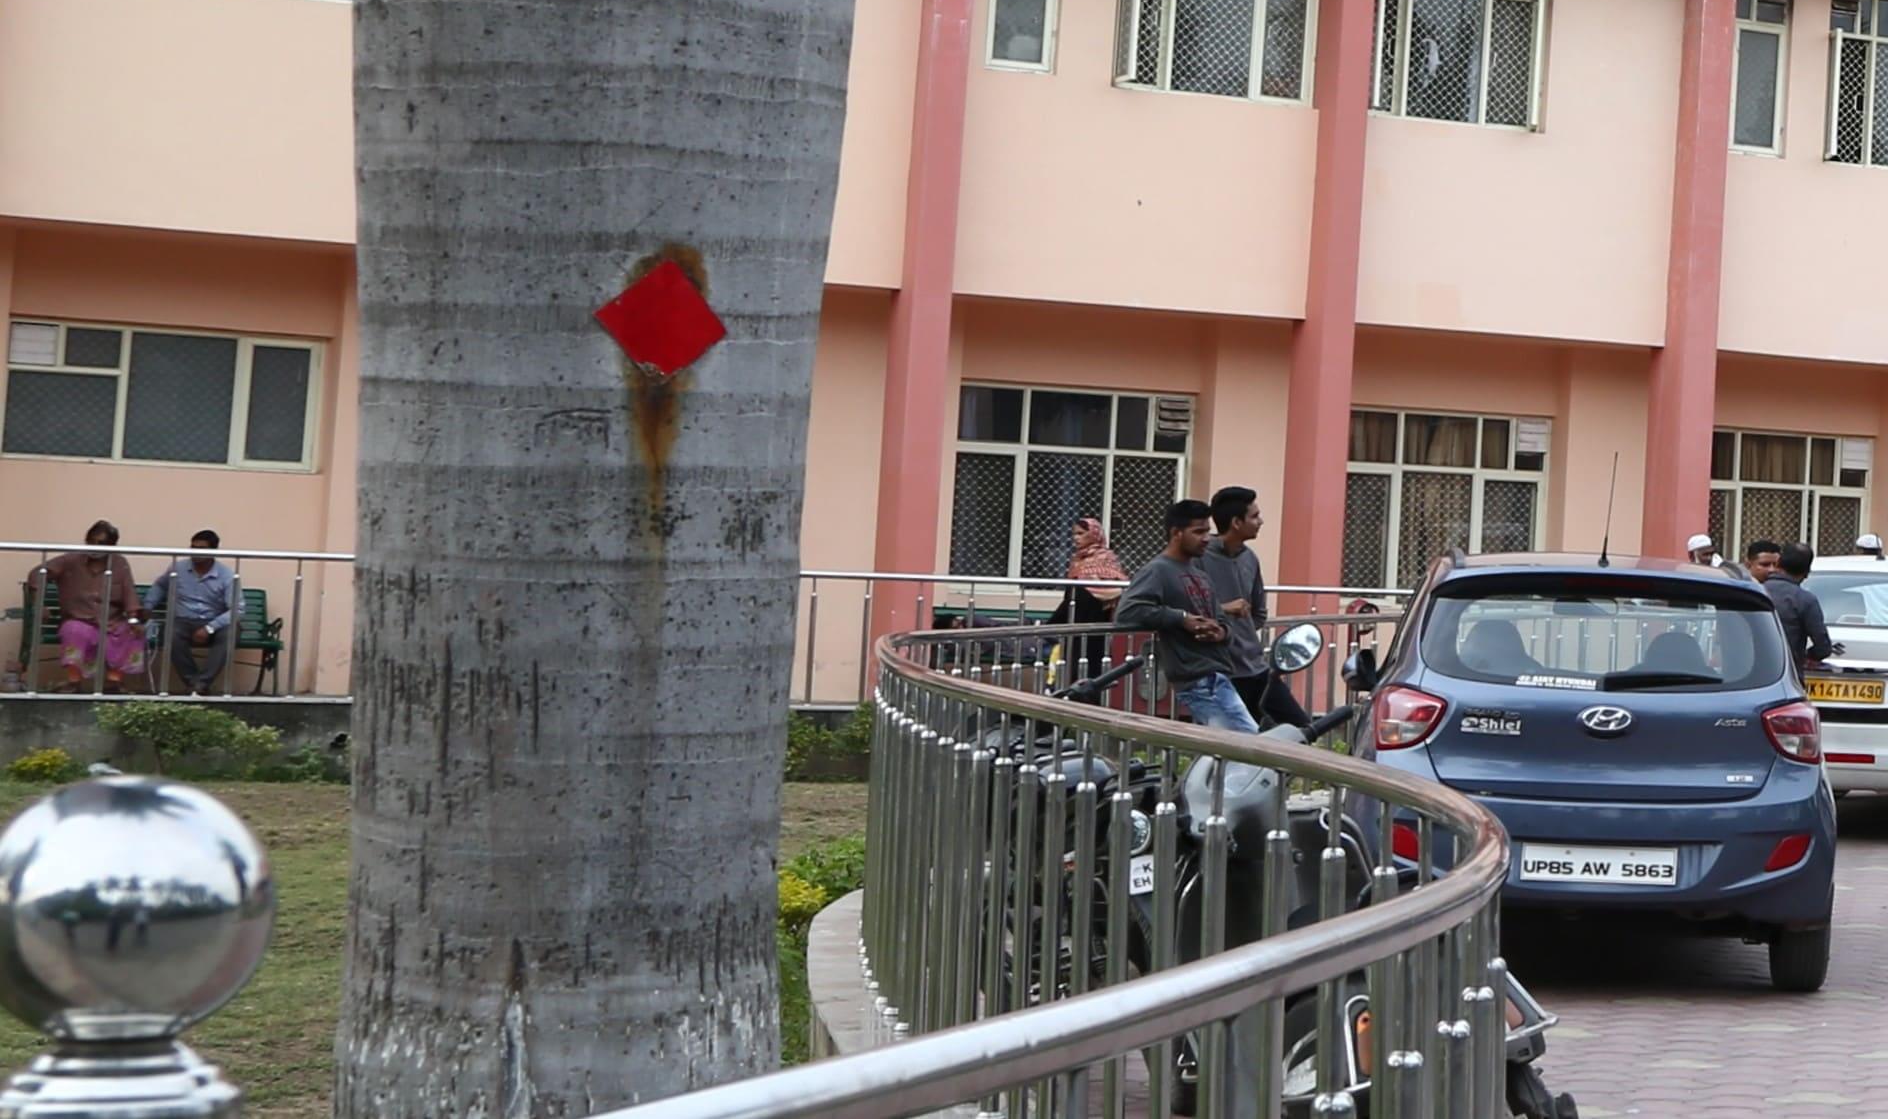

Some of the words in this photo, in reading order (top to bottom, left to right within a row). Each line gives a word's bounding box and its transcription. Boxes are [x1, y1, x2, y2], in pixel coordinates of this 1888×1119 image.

[1806, 682, 1883, 699] K14TA1490
[1523, 859, 1574, 875] UP85
[1580, 862, 1612, 876] AW
[1621, 863, 1674, 878] 5863
